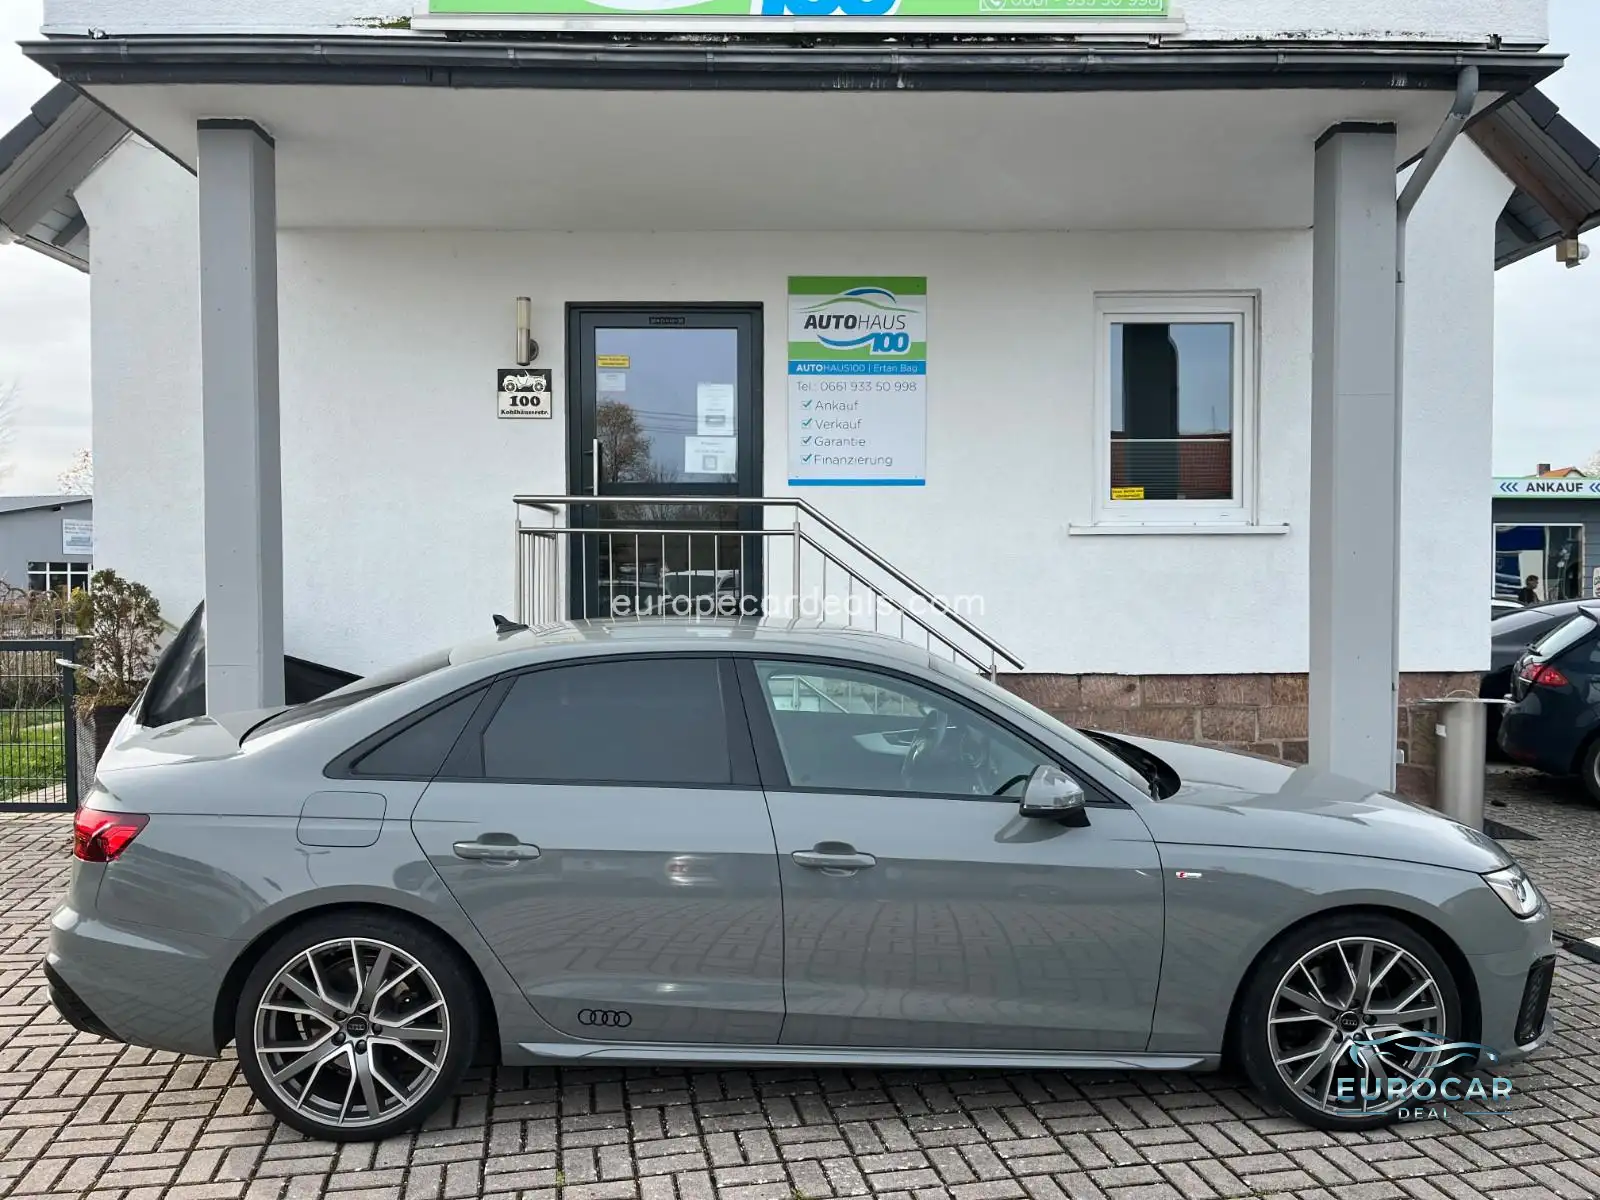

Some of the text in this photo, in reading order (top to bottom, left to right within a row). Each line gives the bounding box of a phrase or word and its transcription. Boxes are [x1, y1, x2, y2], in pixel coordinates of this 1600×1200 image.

[804, 314, 906, 330] AUTOHAUS
[871, 332, 910, 354] 100
[873, 363, 898, 372] Ertan
[820, 381, 847, 391] 0661
[851, 381, 872, 391] 933
[876, 381, 891, 391] 50
[894, 381, 917, 391] 998
[509, 395, 541, 407] 100
[815, 400, 859, 411] Ankauf
[815, 418, 862, 430] Verkauf
[814, 436, 866, 447] Garantie
[814, 454, 893, 467] Finanzierung
[1526, 482, 1584, 493] ANKAUF
